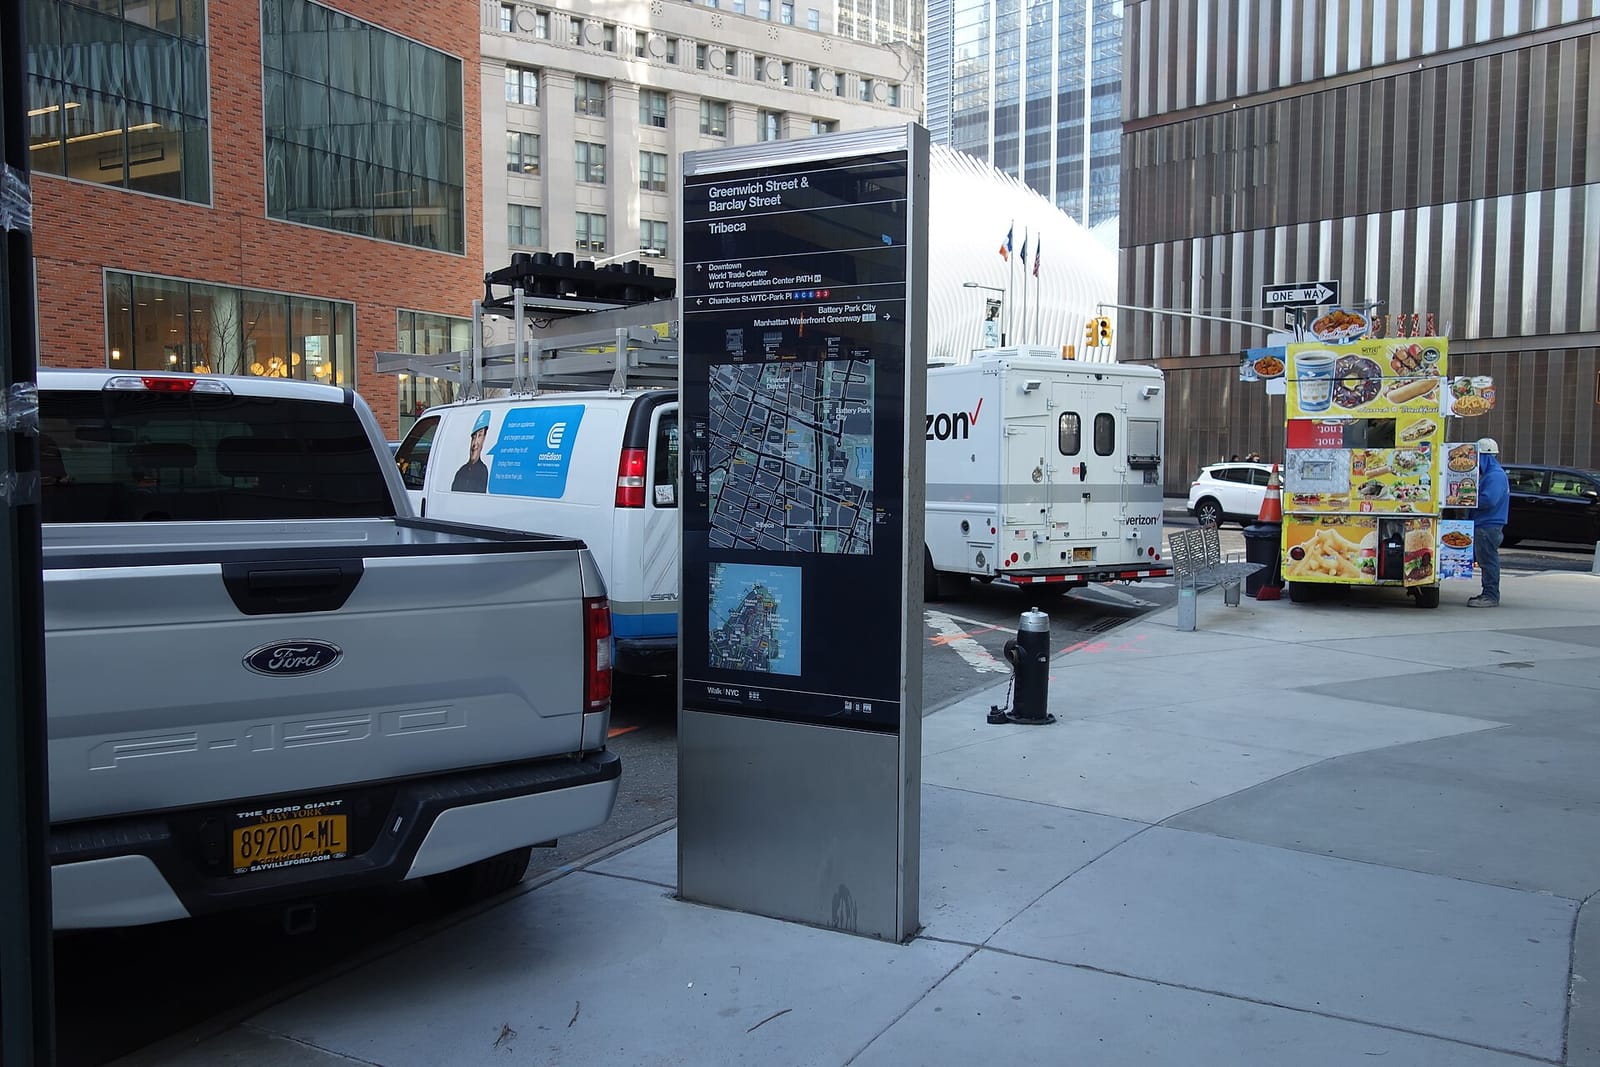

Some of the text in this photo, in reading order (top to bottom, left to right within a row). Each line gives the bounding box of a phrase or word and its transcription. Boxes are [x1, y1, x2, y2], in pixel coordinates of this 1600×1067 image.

[709, 176, 809, 198] Greenwich Street &
[709, 194, 781, 212] Barclay Street
[709, 222, 747, 234] Tribeca
[709, 263, 742, 271] Downtown
[709, 272, 727, 280] World
[727, 271, 745, 279] Trade
[709, 274, 814, 290] WTC Transportation Center PATH
[708, 296, 740, 305] Chambers
[1272, 289, 1327, 302] ONE WAY
[818, 303, 876, 314] Battery Park City
[753, 315, 861, 327] Manhattan Waterfront Greenway
[1126, 514, 1157, 526] verizon
[268, 647, 321, 669] Ford
[707, 686, 723, 695] Walk
[725, 688, 740, 697] NYC
[88, 703, 469, 771] F-150
[236, 799, 343, 819] THE FORD GIANT
[259, 808, 322, 824] NEW YORK
[241, 819, 341, 859] 89200 ML
[250, 854, 331, 872] SAYVILLEFORD.COM
